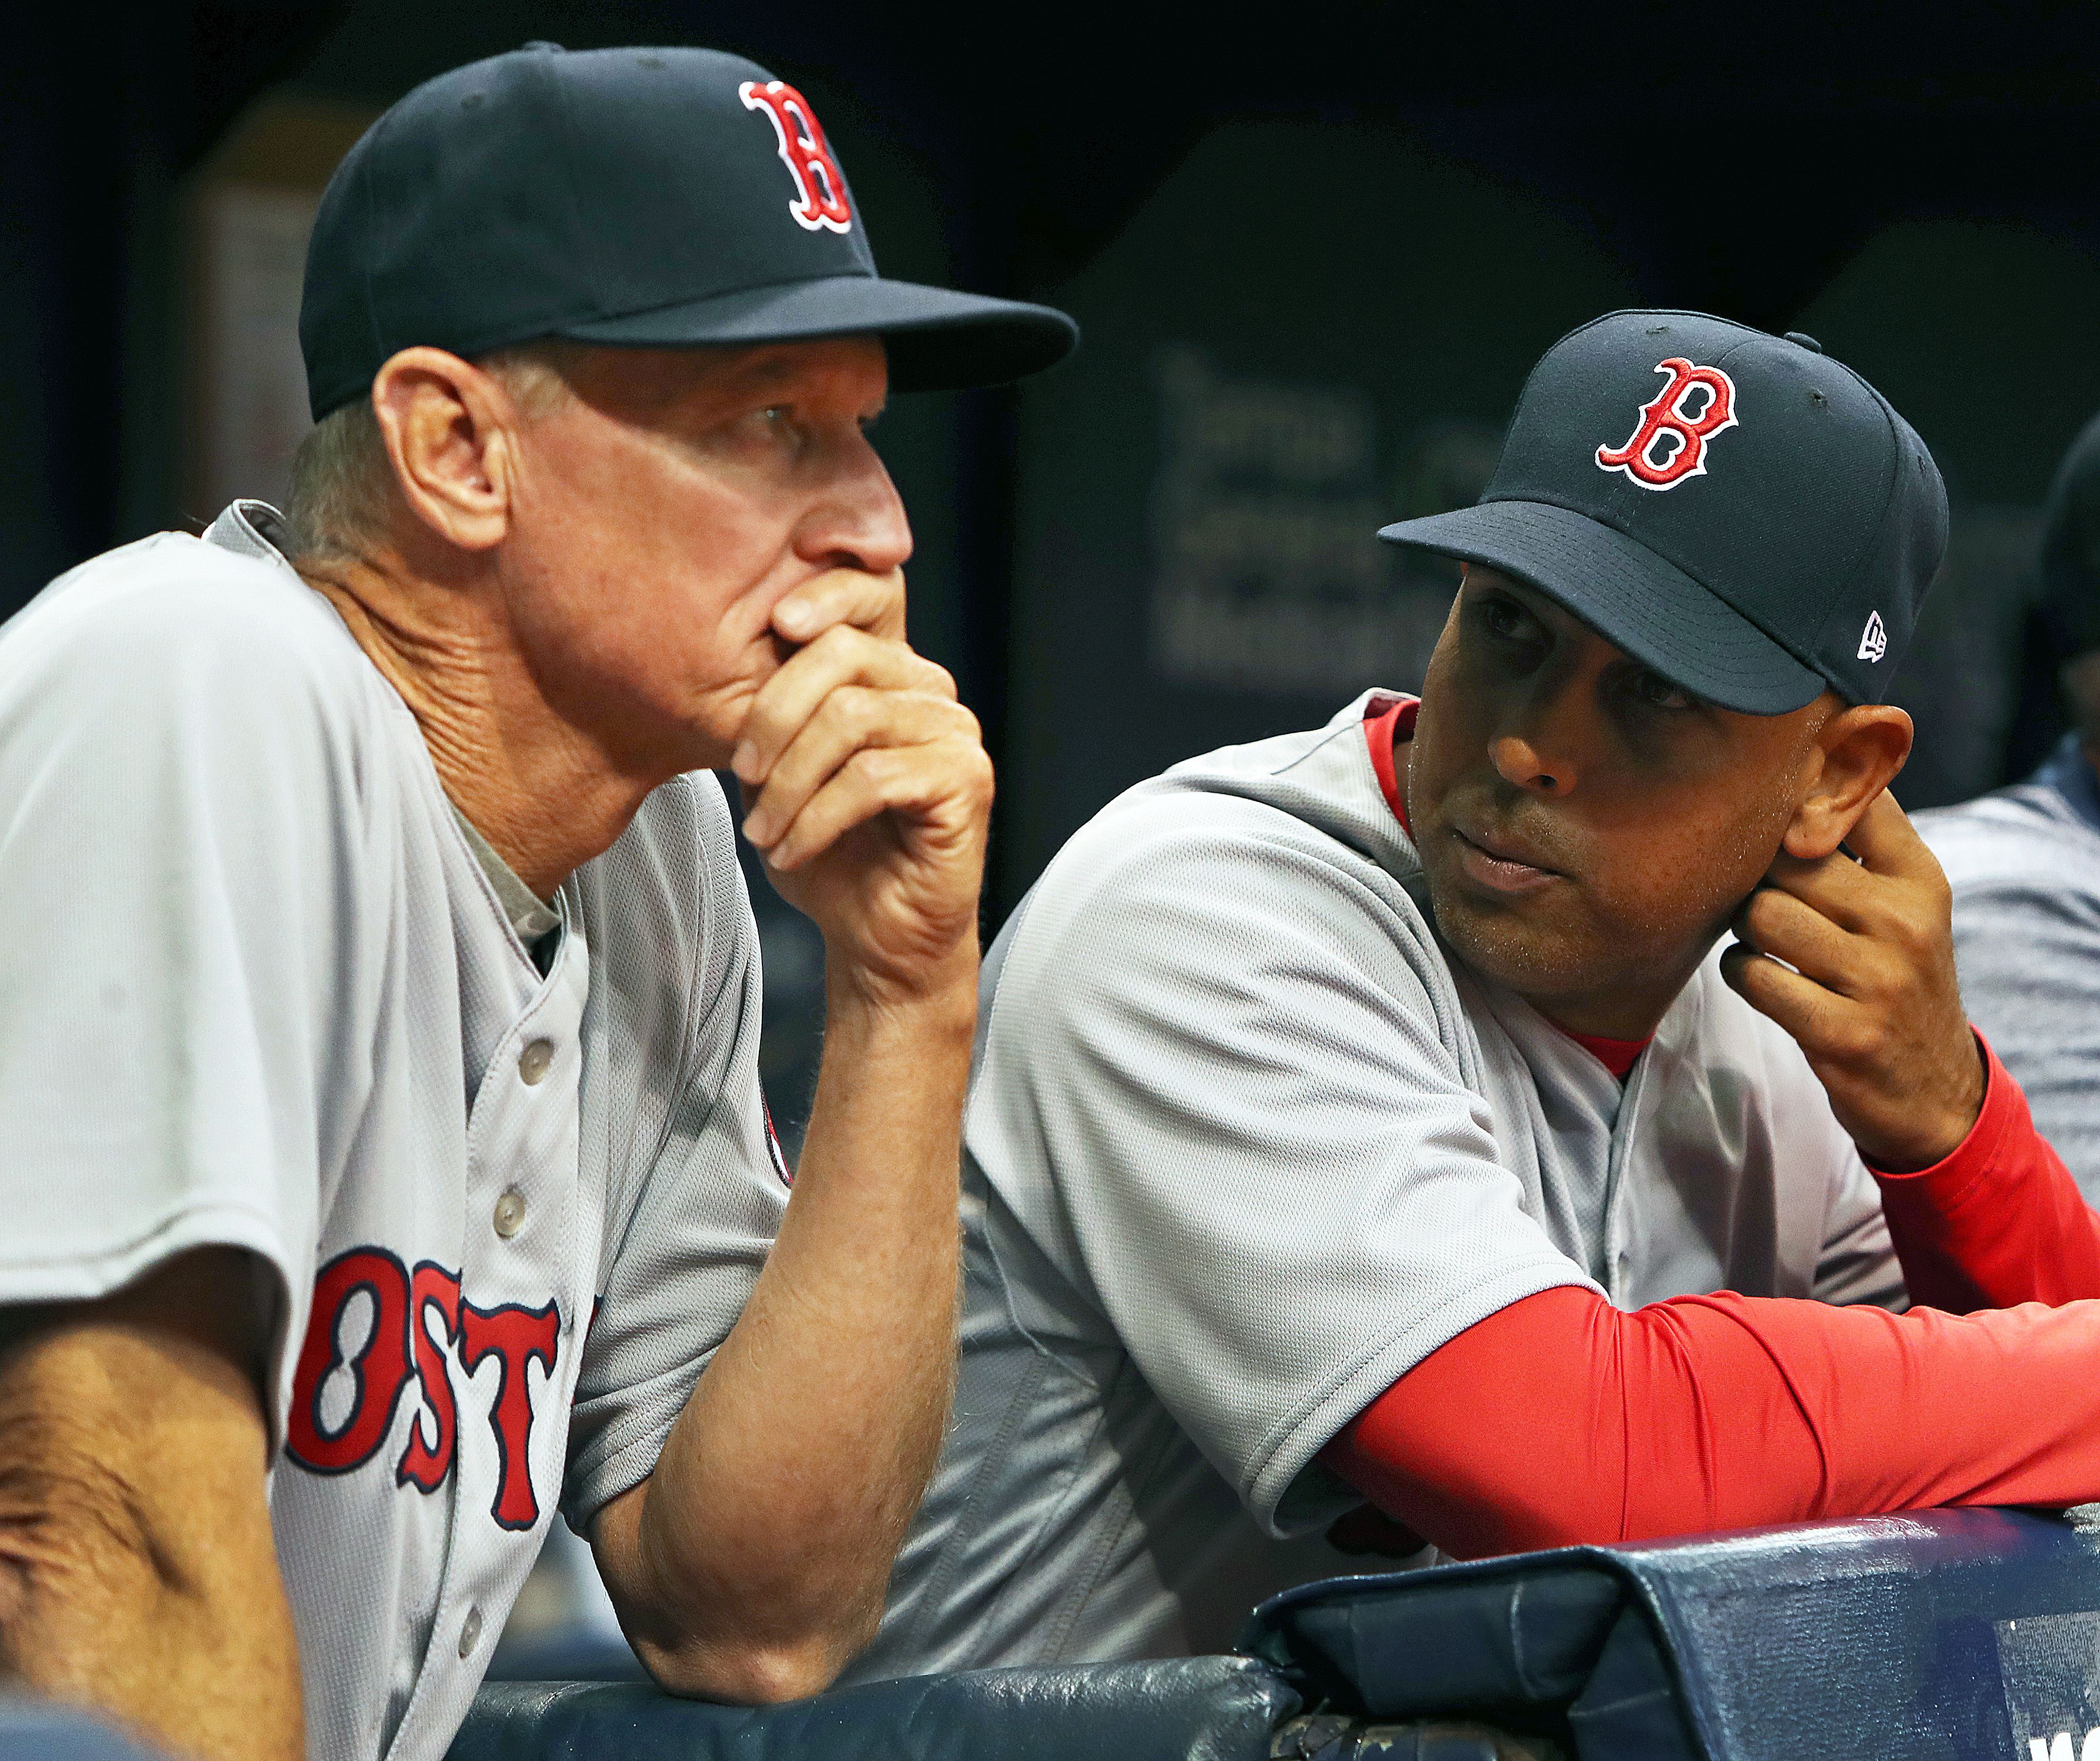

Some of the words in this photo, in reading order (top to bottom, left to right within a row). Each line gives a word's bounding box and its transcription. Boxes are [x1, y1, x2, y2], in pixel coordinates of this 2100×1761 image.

[739, 80, 852, 234] B
[1594, 357, 1739, 491] B
[285, 1244, 602, 1531] OST
